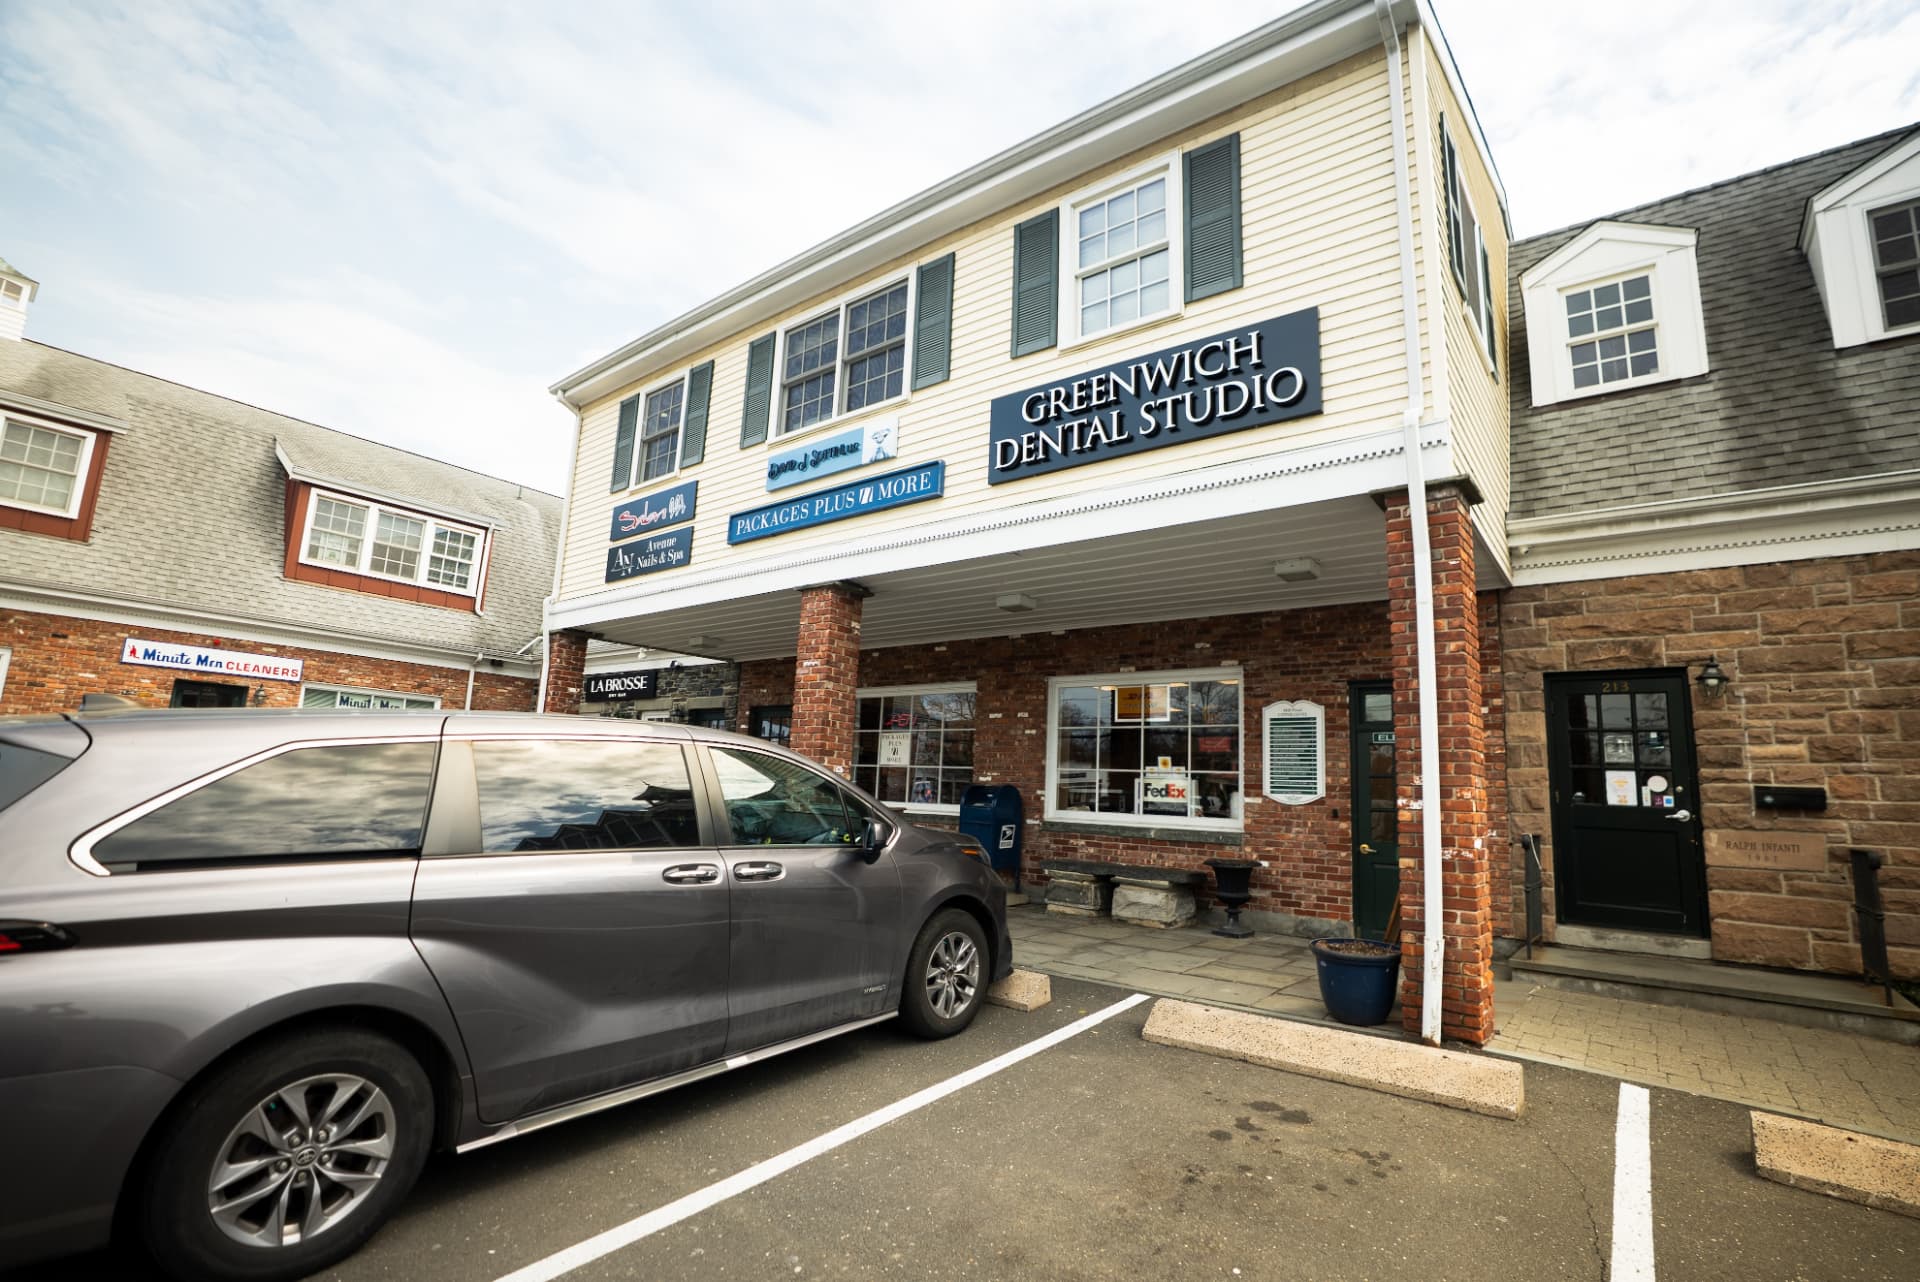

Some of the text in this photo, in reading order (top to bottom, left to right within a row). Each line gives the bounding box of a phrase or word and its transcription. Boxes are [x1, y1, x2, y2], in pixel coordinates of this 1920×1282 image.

[1021, 330, 1261, 423] GREENWICH
[994, 366, 1305, 470] DENTAL STUDIO
[735, 502, 809, 536] PACKAGES
[813, 490, 855, 516] PLUS
[878, 471, 931, 501] MORE
[645, 536, 677, 553] Avenue
[635, 548, 684, 570] Nails & Spa
[225, 660, 299, 679] CLEANERS
[590, 675, 649, 693] LA BROSSE
[1601, 681, 1631, 693] 213
[1144, 783, 1186, 799] FedEx
[1725, 840, 1801, 854] RALPH INFANTI
